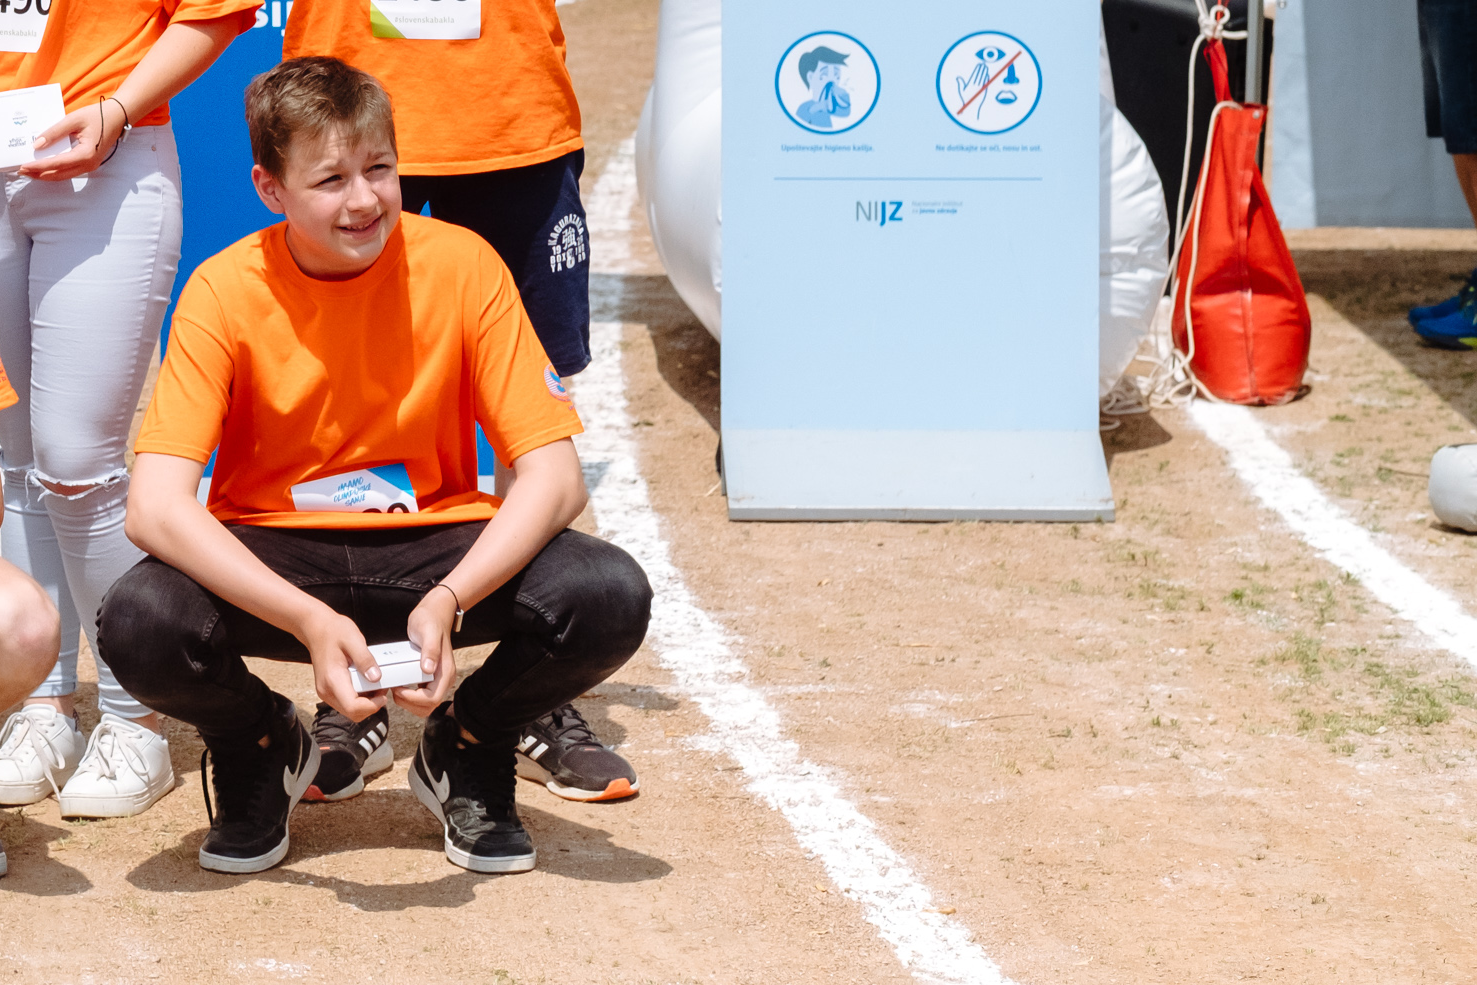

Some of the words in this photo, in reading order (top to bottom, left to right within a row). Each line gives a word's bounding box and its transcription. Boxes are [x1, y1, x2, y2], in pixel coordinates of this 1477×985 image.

[394, 16, 455, 24] #slovenskabakla
[855, 200, 903, 227] NIJZ
[552, 244, 562, 256] 19
[337, 476, 364, 491] IMAMO
